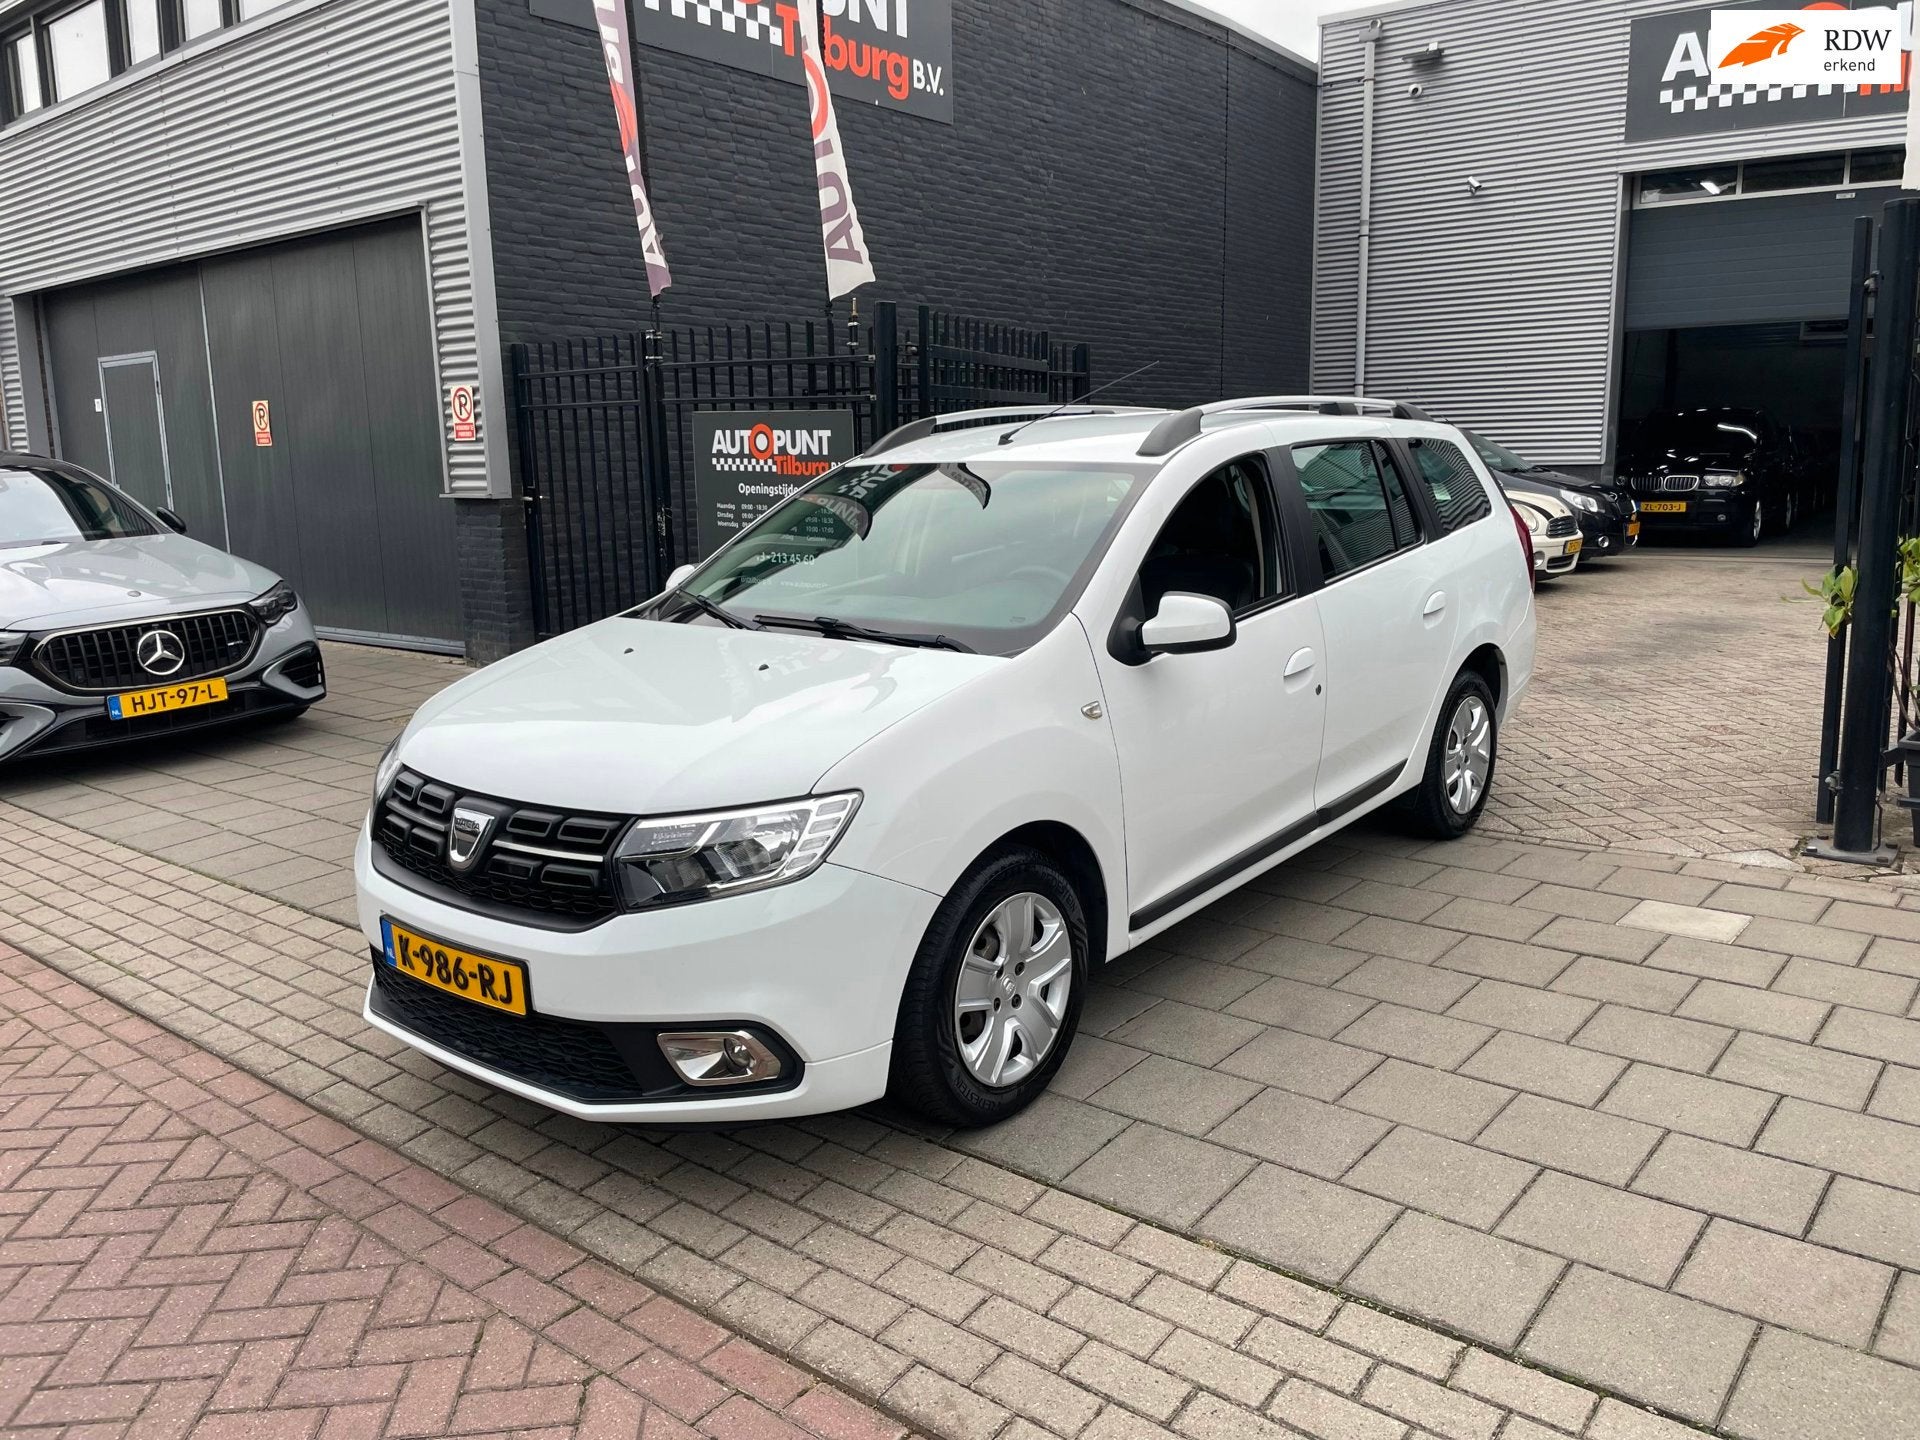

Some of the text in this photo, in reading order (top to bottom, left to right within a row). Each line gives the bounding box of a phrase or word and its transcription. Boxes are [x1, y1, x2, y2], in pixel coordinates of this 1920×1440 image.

[775, 3, 909, 101] Tburg
[712, 424, 831, 460] AUTOPUNT
[1644, 503, 1681, 511] ZL-703-J
[771, 551, 788, 565] 213
[789, 553, 801, 565] 45
[131, 684, 219, 713] HJT-97-L
[398, 934, 512, 1005] K-986-RJ
